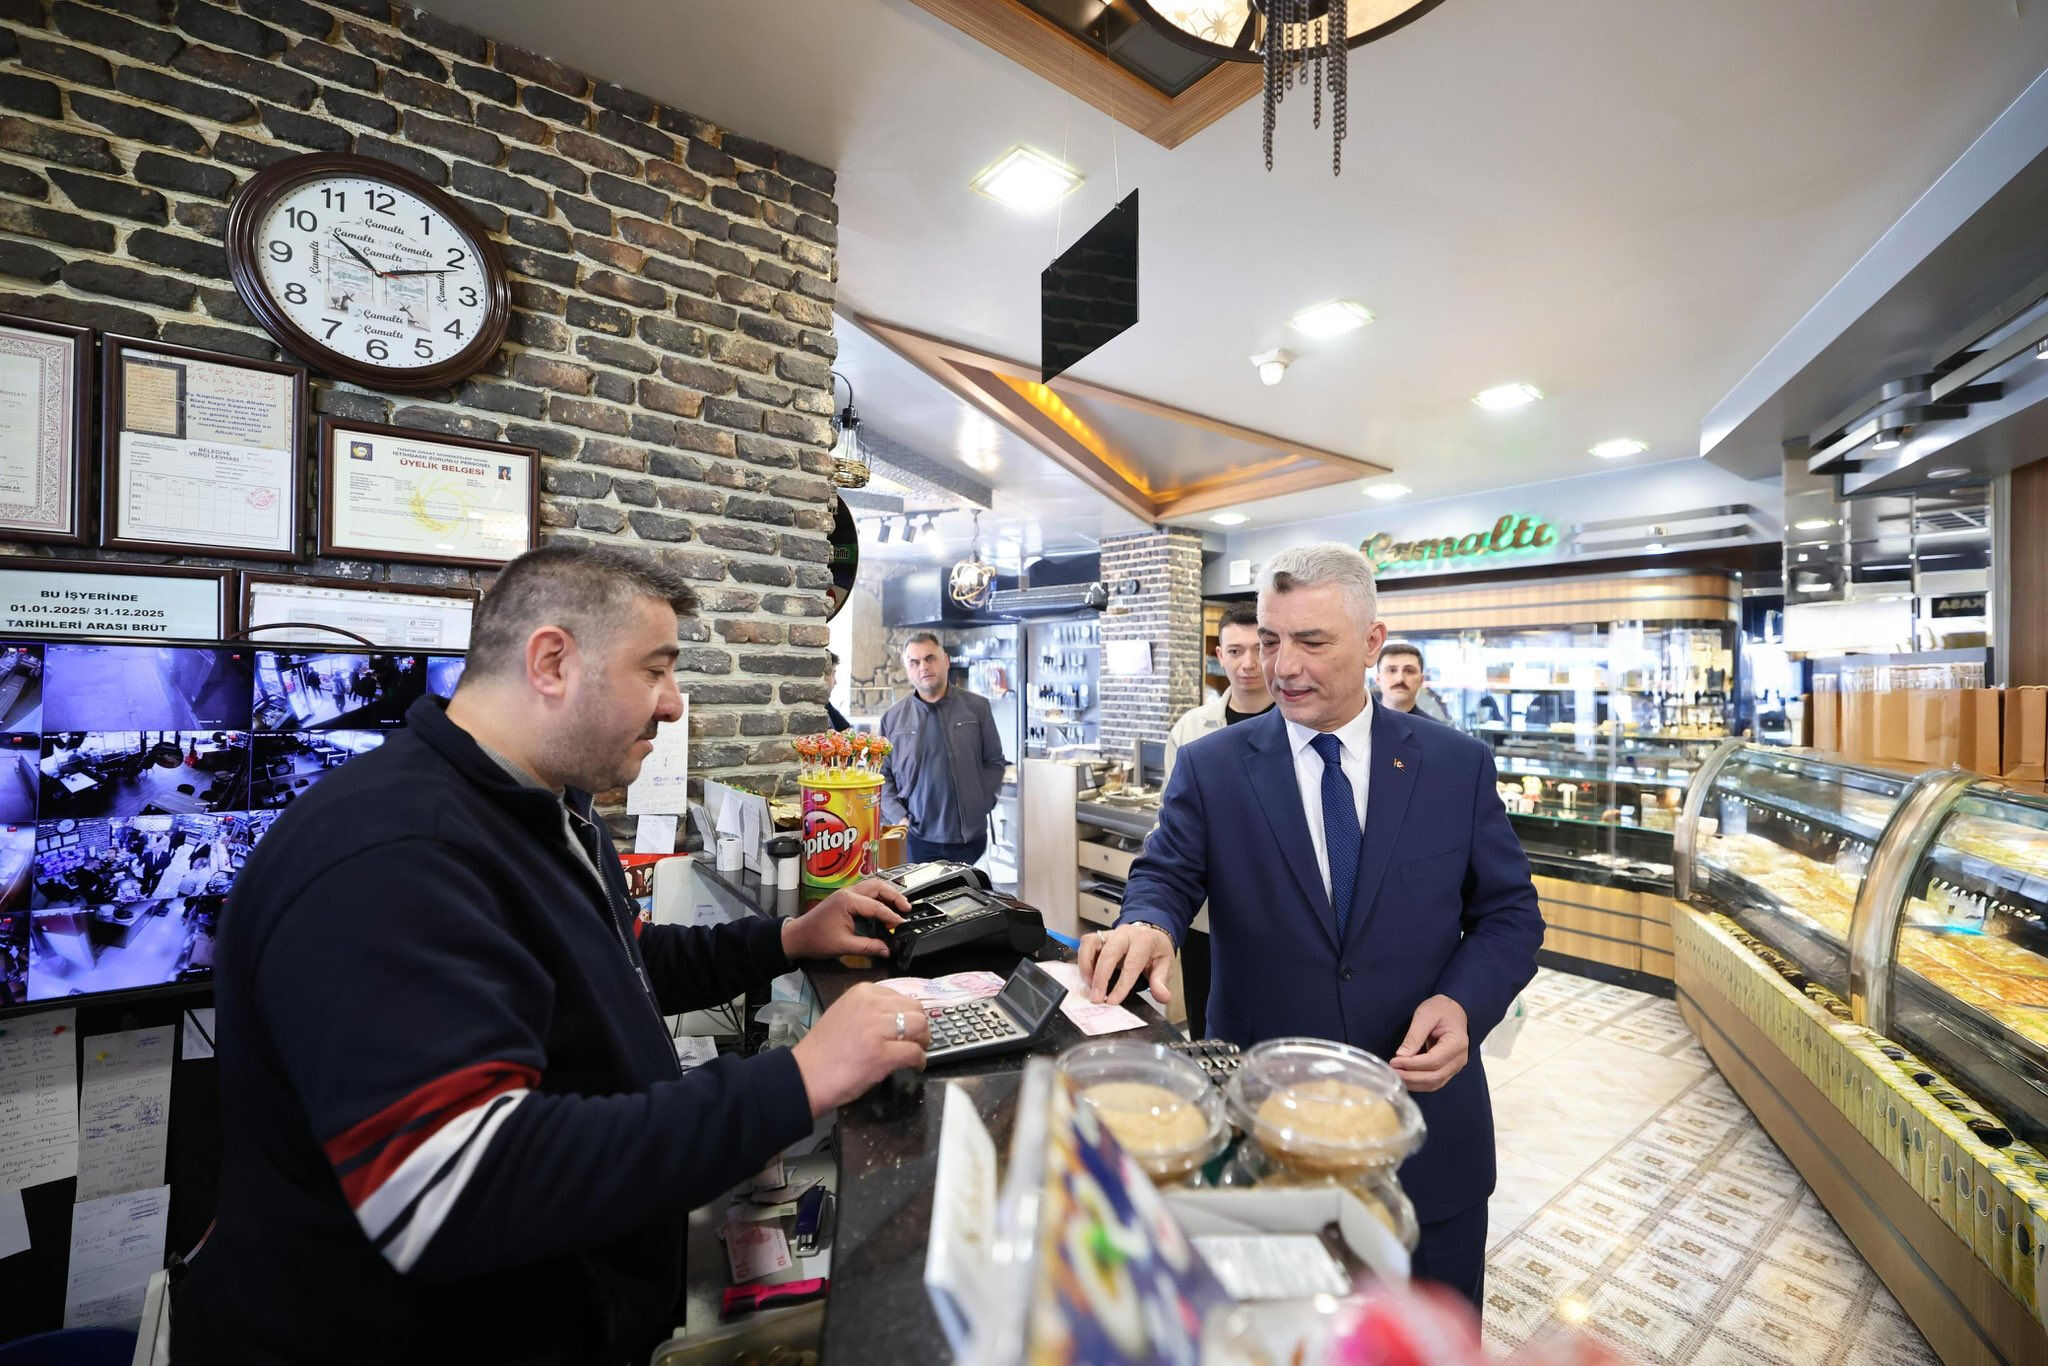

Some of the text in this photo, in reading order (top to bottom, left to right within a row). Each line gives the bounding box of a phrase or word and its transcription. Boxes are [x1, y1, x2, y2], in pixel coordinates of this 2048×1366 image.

[320, 188, 345, 212] 11
[364, 189, 396, 216] 12
[284, 206, 318, 232] 10
[420, 216, 430, 236] 1
[268, 240, 293, 263] 9
[446, 248, 465, 270] 2
[284, 282, 308, 305] 8
[458, 286, 478, 307] 3
[321, 318, 342, 340] 7
[444, 318, 464, 340] 4
[366, 339, 389, 360] 6
[414, 338, 434, 359] 5
[400, 458, 485, 476] ÜYELİK BELGESİ
[40, 590, 138, 601] BU İŞYERİNDE
[10, 604, 164, 618] 01.01.2025/ 31.12.2025
[6, 619, 168, 632] TARİHLERİ ARASI BRÜT
